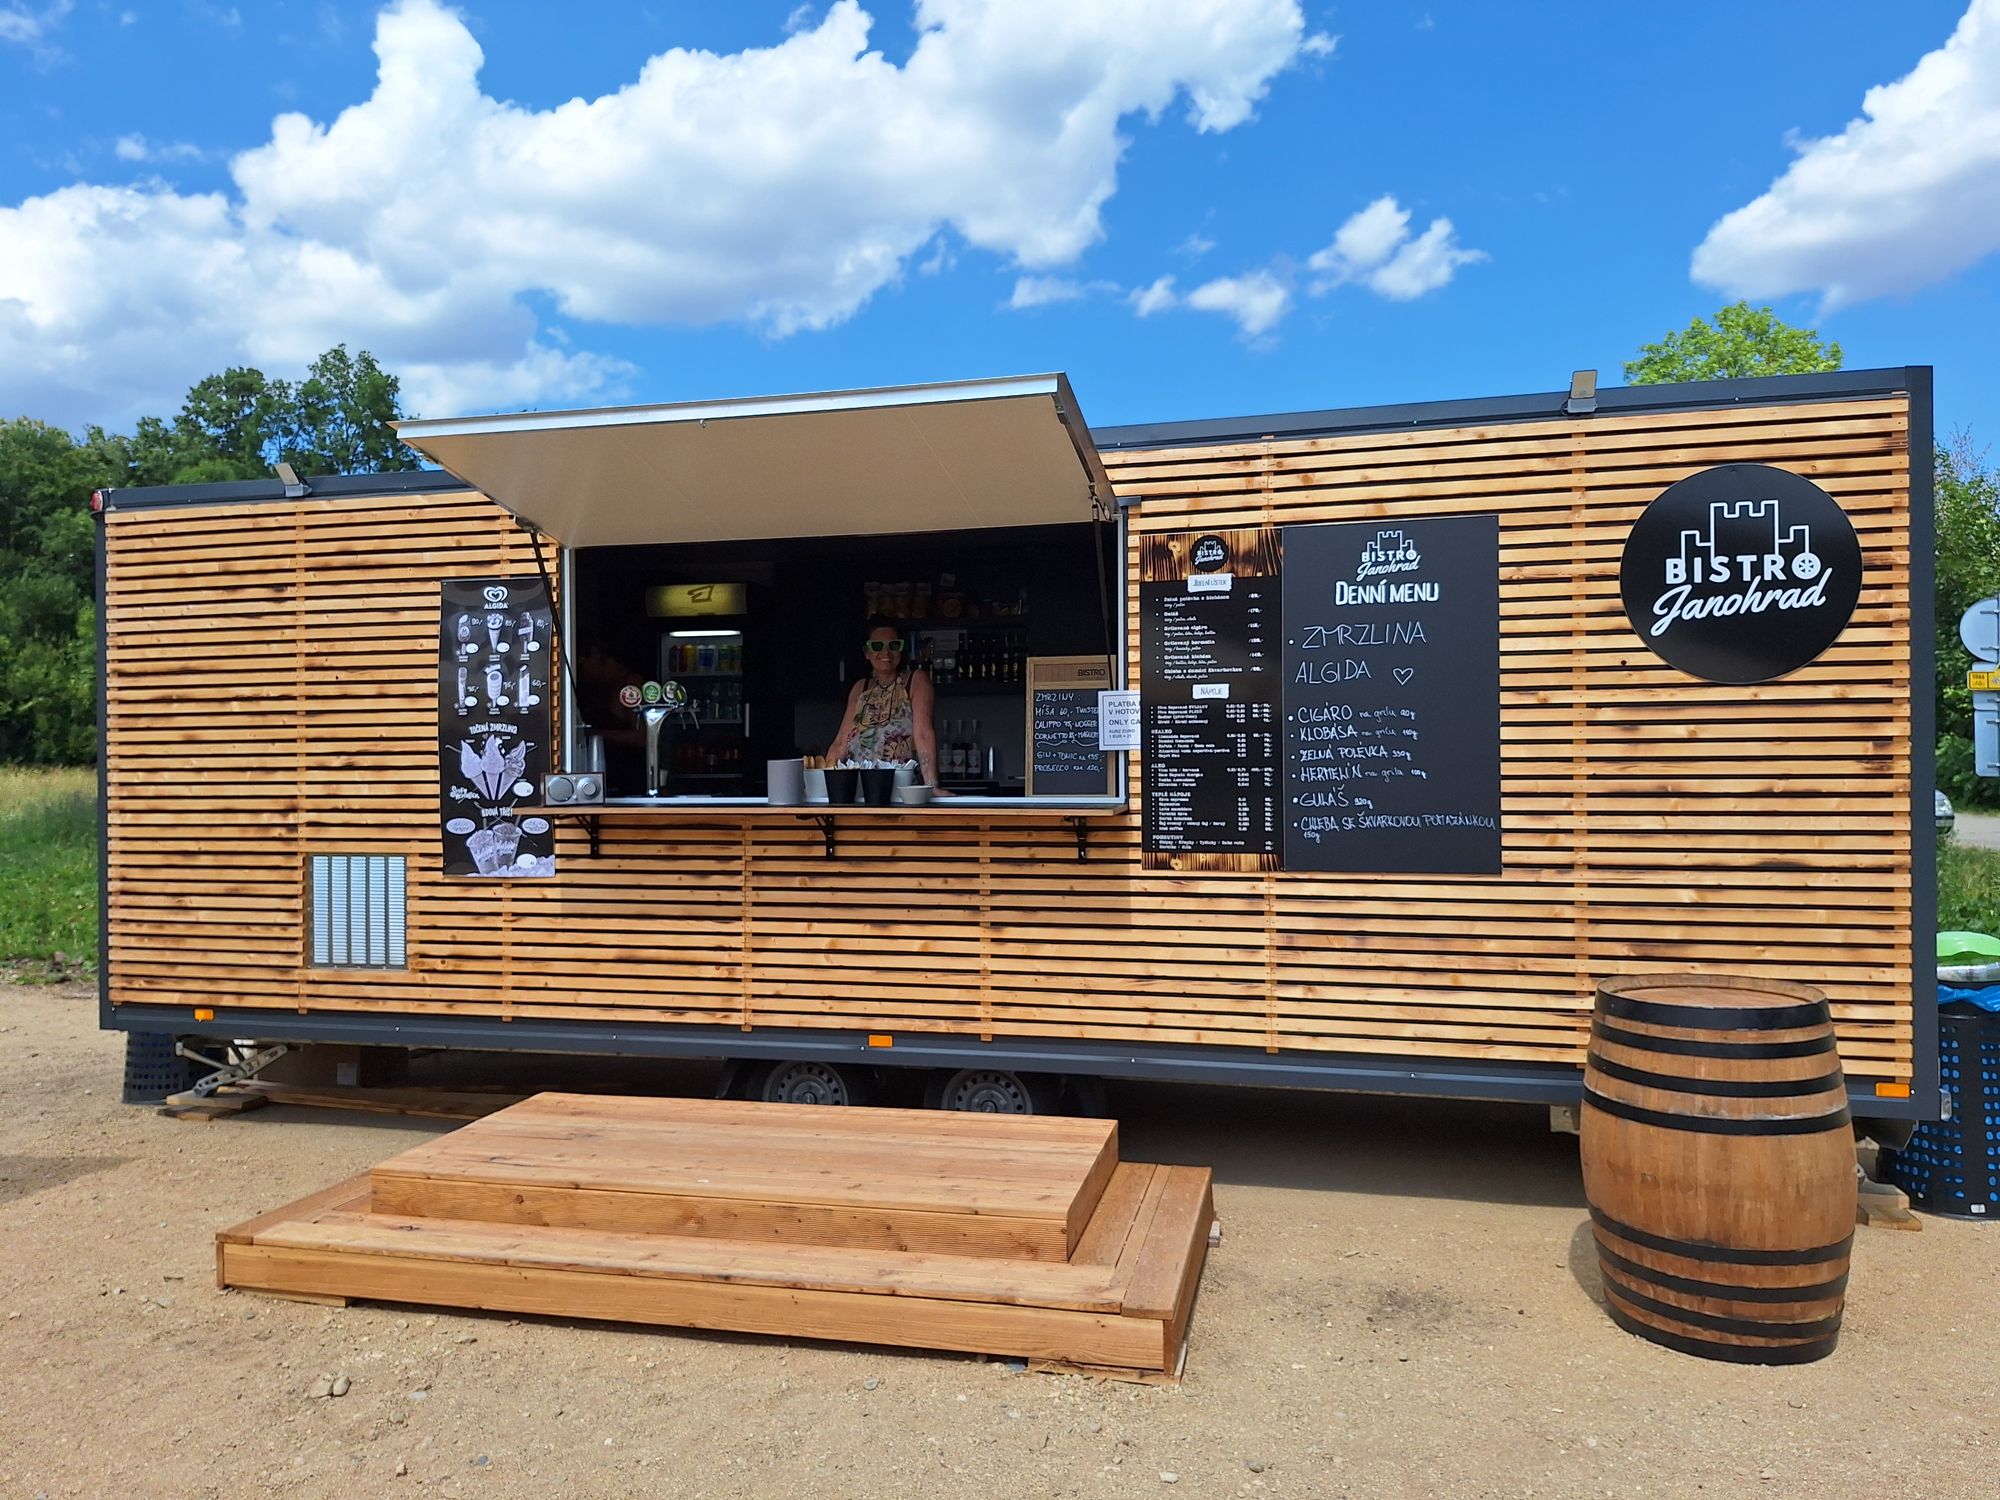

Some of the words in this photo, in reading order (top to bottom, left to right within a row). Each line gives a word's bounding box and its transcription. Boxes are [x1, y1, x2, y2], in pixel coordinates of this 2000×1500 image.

[1361, 549, 1417, 563] BISTRO
[1355, 554, 1421, 582] Janohrad
[1665, 552, 1822, 585] BISTRO
[1335, 579, 1386, 606] DENNÍ
[1390, 582, 1440, 603] MENU
[1650, 567, 1833, 637] Janohrad
[1302, 620, 1427, 648] ZMRZLINA
[1078, 668, 1106, 677] BISTRO
[1295, 659, 1371, 684] ALGIDA
[1298, 702, 1352, 724] CIGÁRO
[1359, 710, 1371, 718] na
[469, 722, 489, 734] TOČENÁ
[1300, 722, 1358, 742] KLOBÁSA
[1300, 744, 1334, 762] ZELNÁ
[1338, 742, 1388, 760] POLÉVKA
[1300, 762, 1362, 783] HERMELÍN
[1300, 784, 1349, 808] GULÁŠ
[1300, 816, 1340, 832] CHLEBA
[1342, 818, 1356, 830] SE
[1358, 811, 1422, 829] ŠKVARKOVOU
